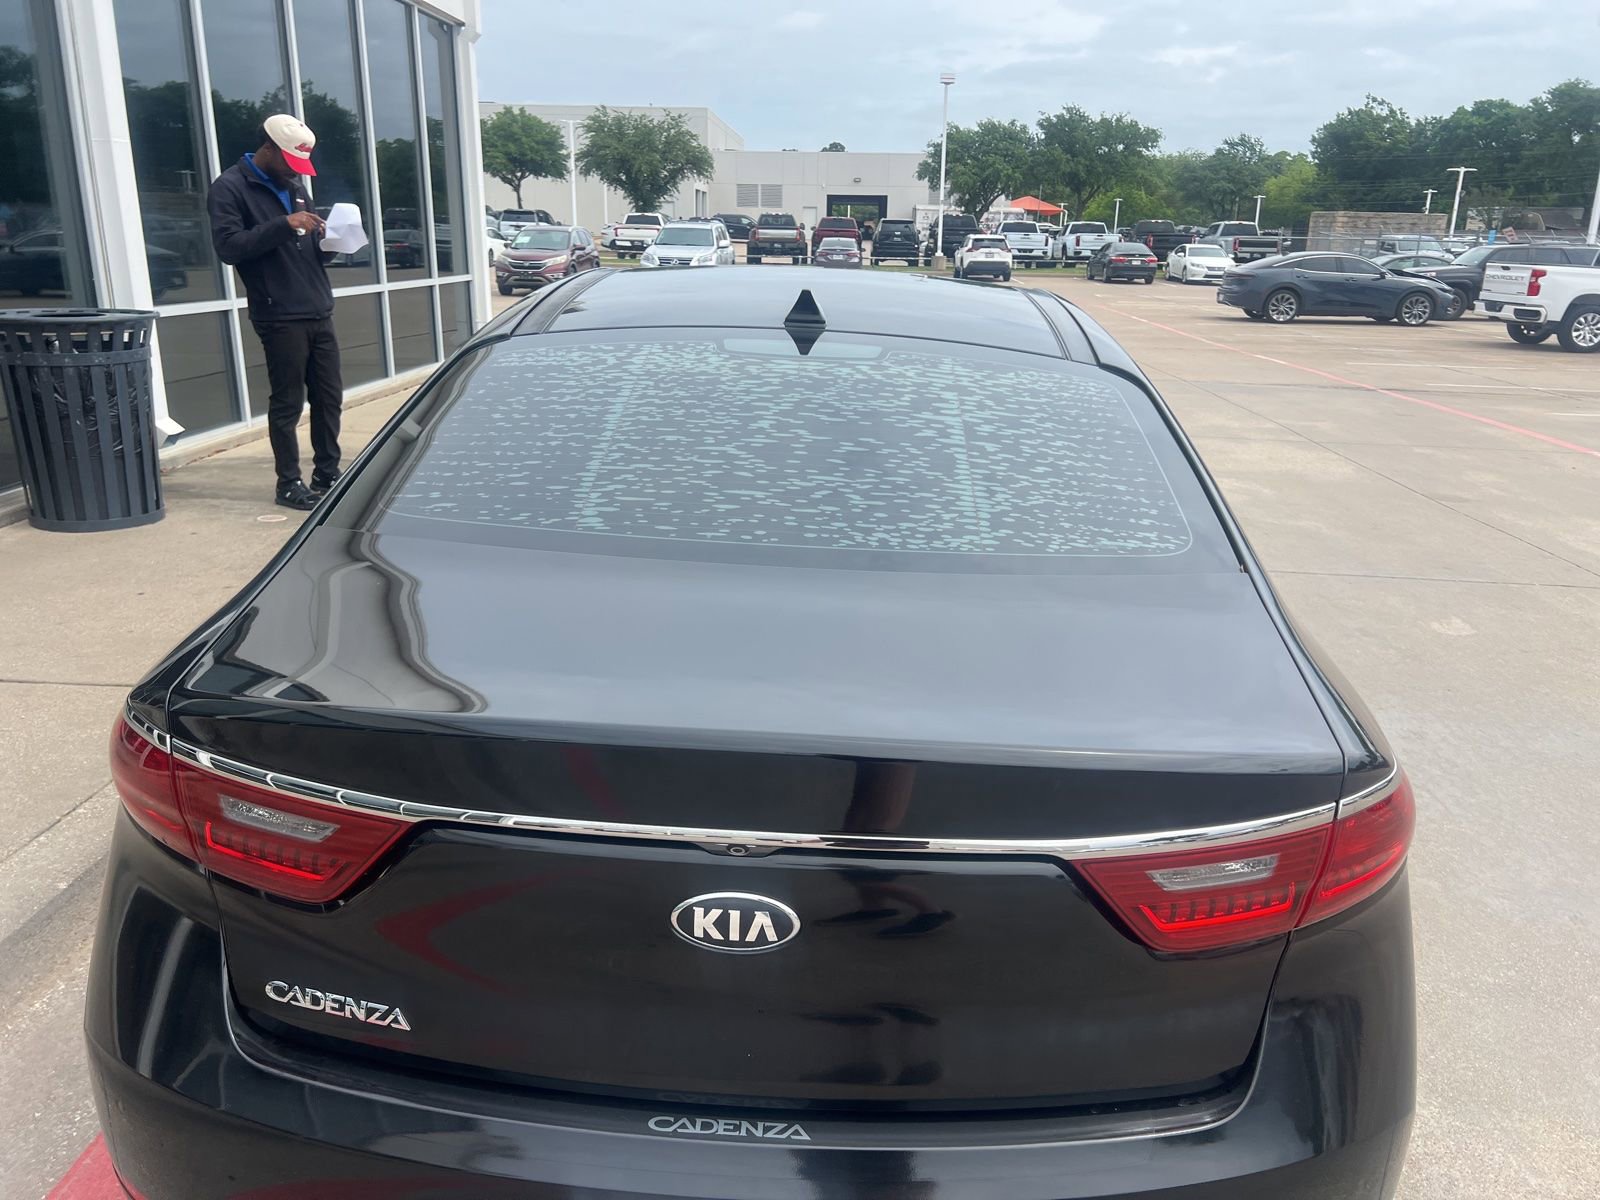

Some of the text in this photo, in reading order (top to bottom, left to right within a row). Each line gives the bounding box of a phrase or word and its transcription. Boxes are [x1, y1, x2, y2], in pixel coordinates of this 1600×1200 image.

[692, 906, 779, 942] KIA
[264, 980, 412, 1031] CADENZA
[647, 1116, 812, 1141] CADENZA
